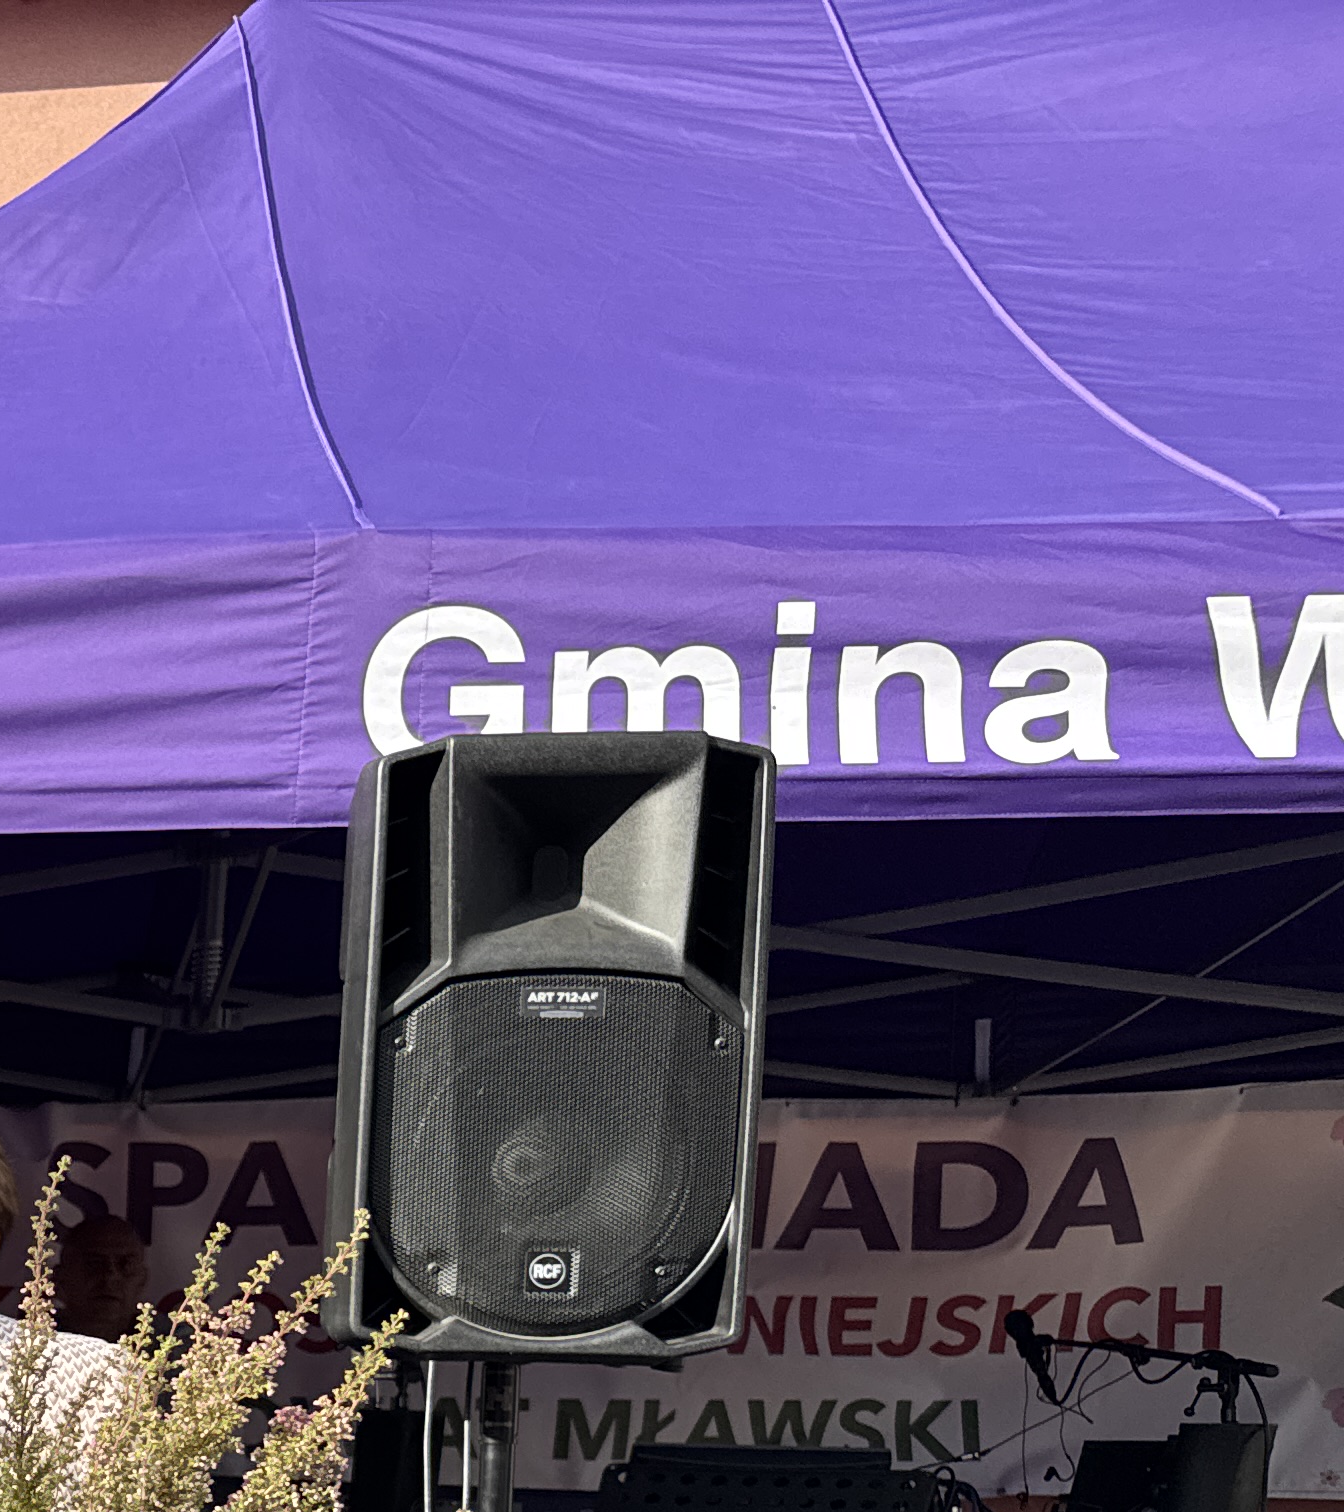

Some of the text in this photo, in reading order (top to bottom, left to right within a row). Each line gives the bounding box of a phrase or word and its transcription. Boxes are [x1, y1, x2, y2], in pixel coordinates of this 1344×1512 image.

[361, 601, 1120, 765] Gmina
[527, 991, 555, 1003] ART
[533, 1263, 562, 1279] RCF
[553, 1398, 980, 1462] MŁAWSKI
